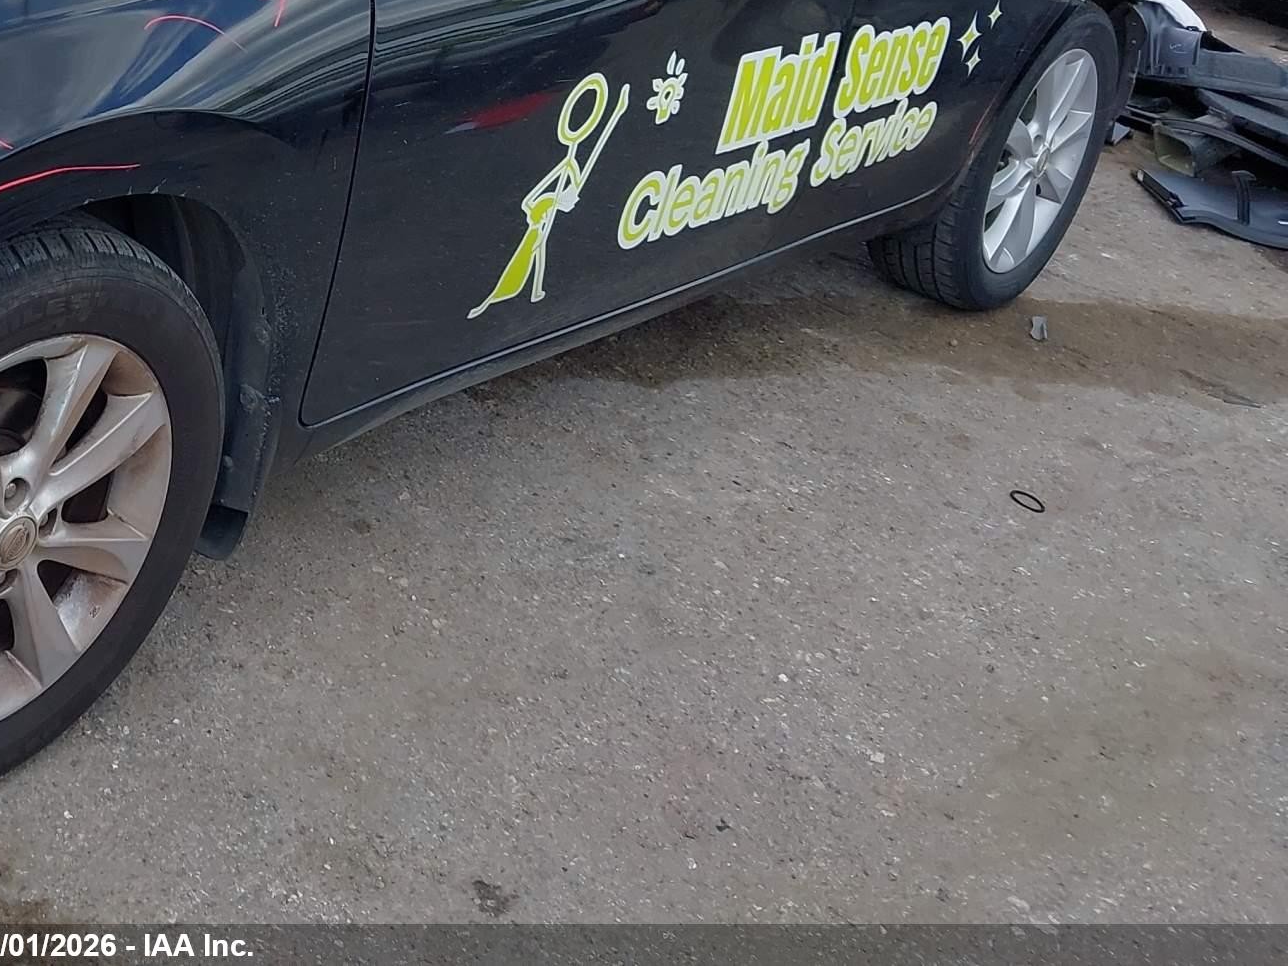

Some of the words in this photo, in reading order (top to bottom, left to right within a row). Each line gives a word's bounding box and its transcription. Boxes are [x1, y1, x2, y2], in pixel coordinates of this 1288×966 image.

[716, 32, 841, 155] Maid
[833, 16, 951, 119] Sense
[617, 140, 811, 250] Cleaning
[809, 100, 939, 187] Service
